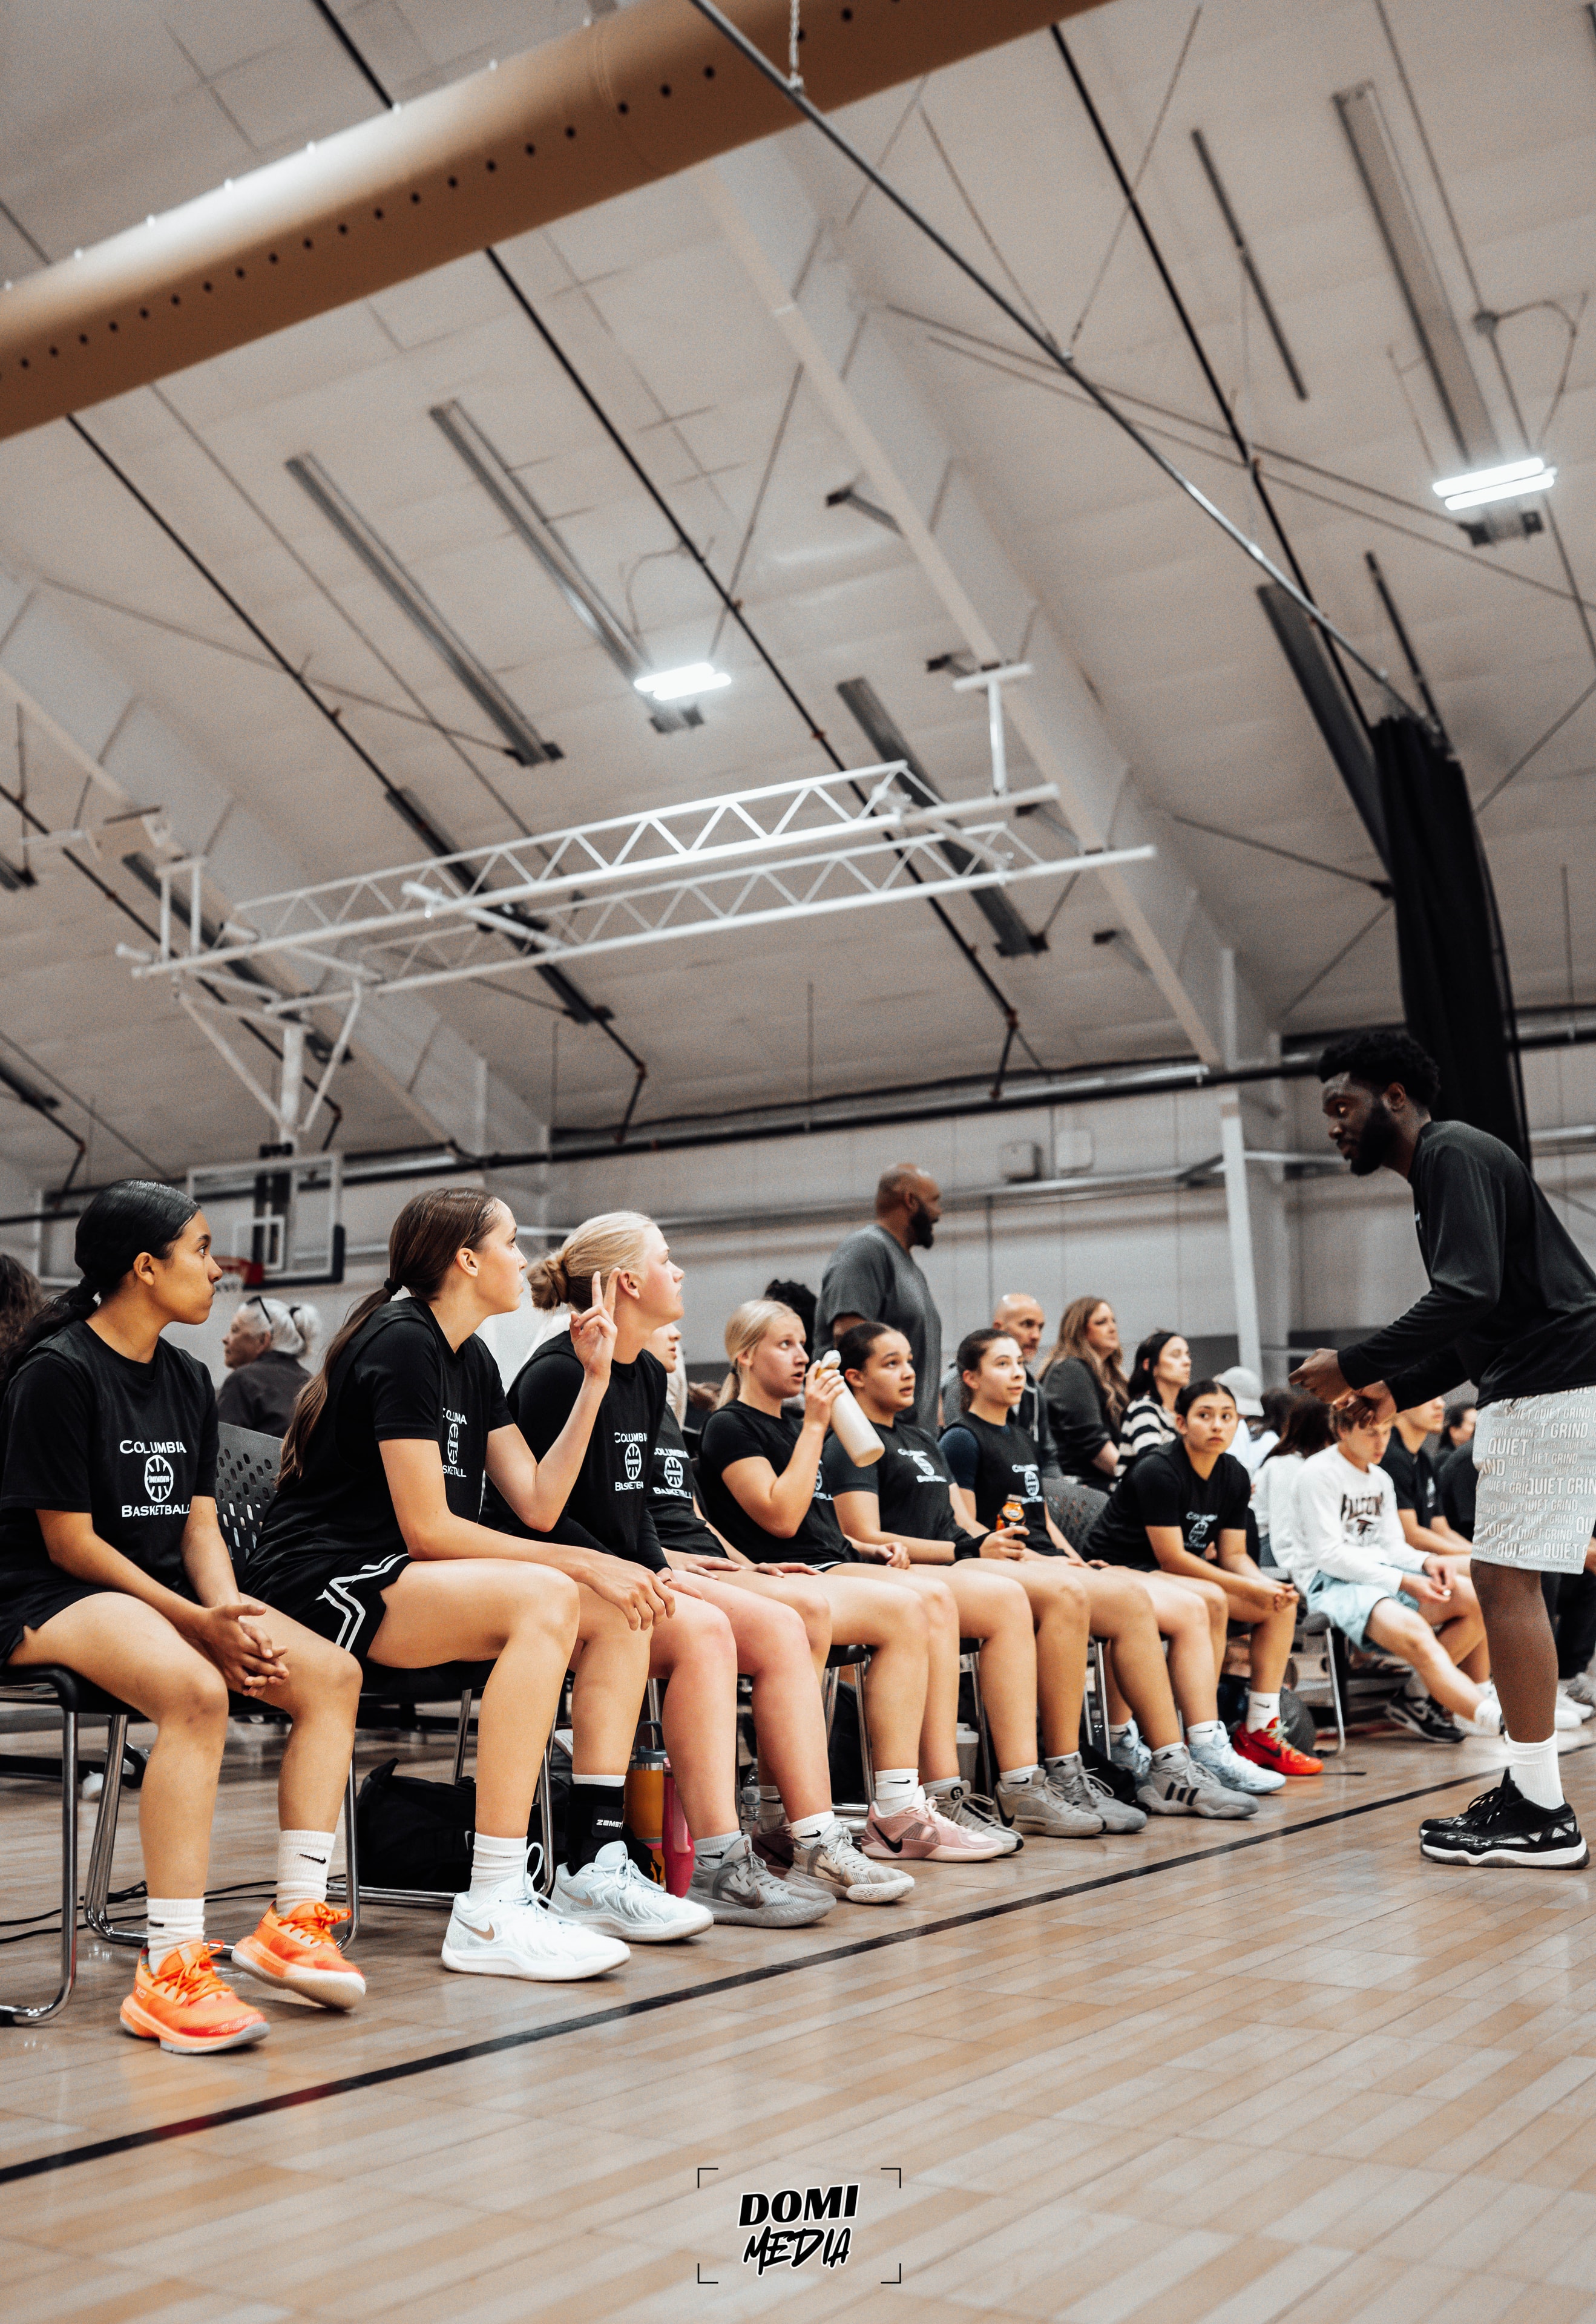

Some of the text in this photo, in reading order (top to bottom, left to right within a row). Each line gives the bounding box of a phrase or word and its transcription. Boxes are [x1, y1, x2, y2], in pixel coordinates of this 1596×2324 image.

[1563, 1407, 1591, 1420] GRIND
[1550, 1422, 1589, 1439] GRIND
[119, 1440, 188, 1454] COLUMBIA
[1488, 1437, 1530, 1457] QUIET
[1551, 1452, 1578, 1465] GRIND
[122, 1504, 191, 1518] BASKETBALL
[1551, 1499, 1578, 1512] GRIND
[1545, 1528, 1573, 1541] GRIND
[1543, 1542, 1580, 1560] QUIET
